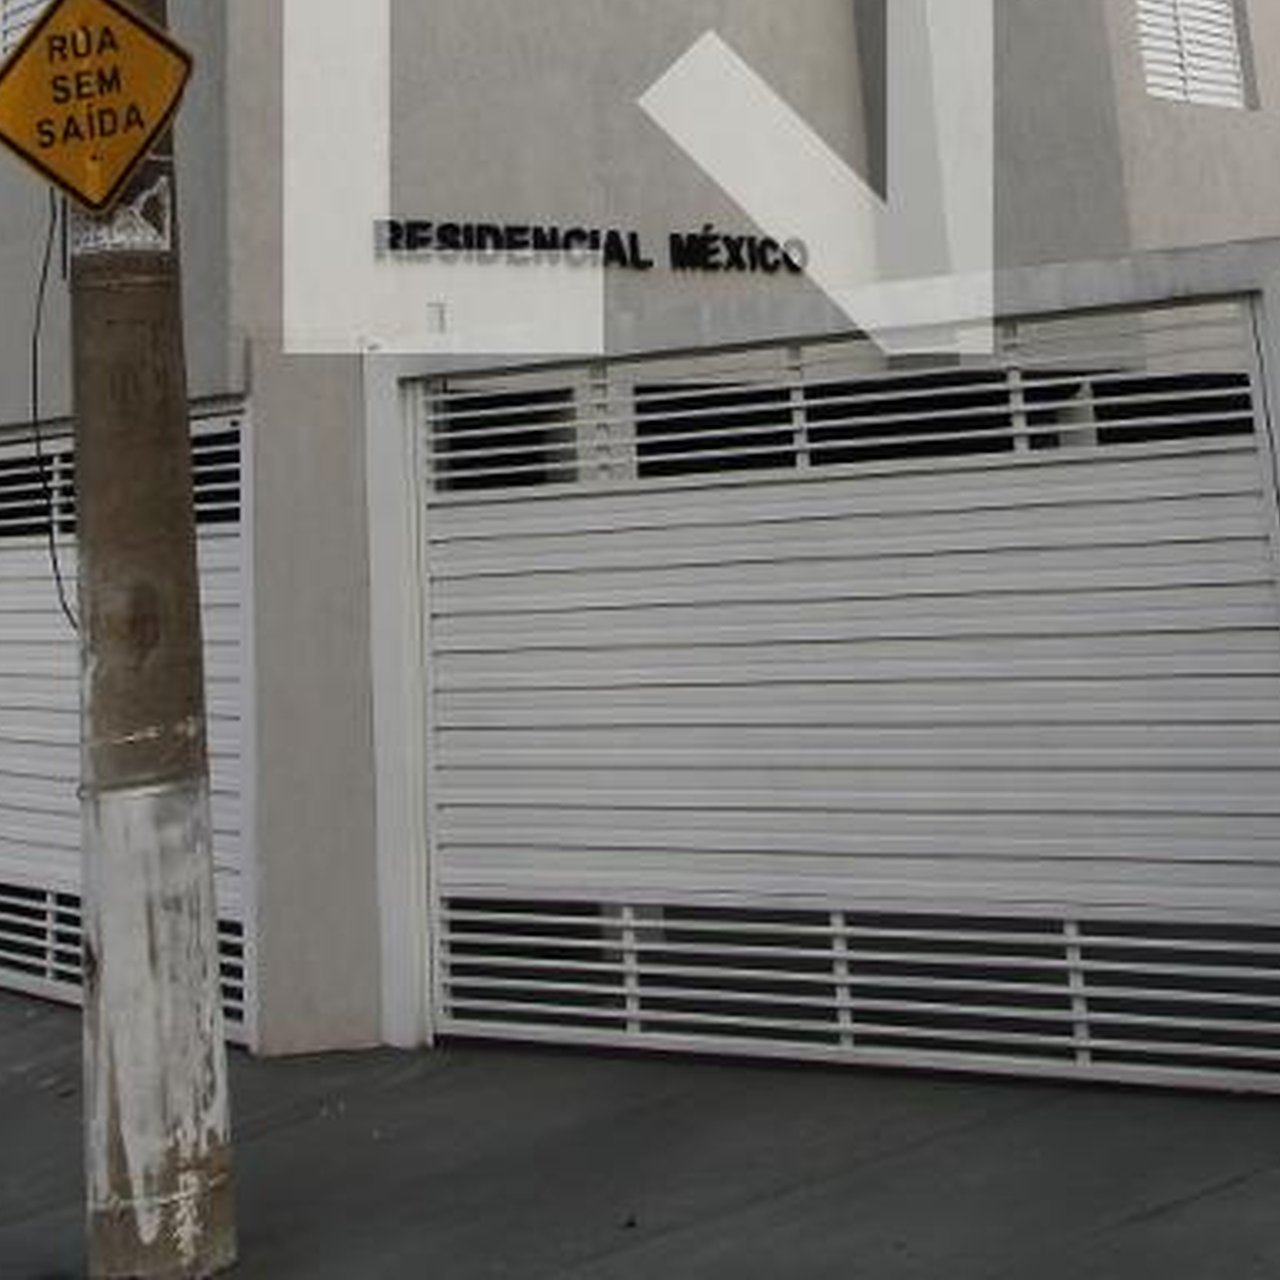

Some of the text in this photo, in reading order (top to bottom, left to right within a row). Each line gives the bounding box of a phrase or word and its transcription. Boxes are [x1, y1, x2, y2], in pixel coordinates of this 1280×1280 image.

[48, 25, 120, 62] RUA
[51, 66, 122, 105] SEM
[35, 102, 145, 148] SAÍDA
[375, 219, 809, 274] RESIDENCIAL MÉXICO
